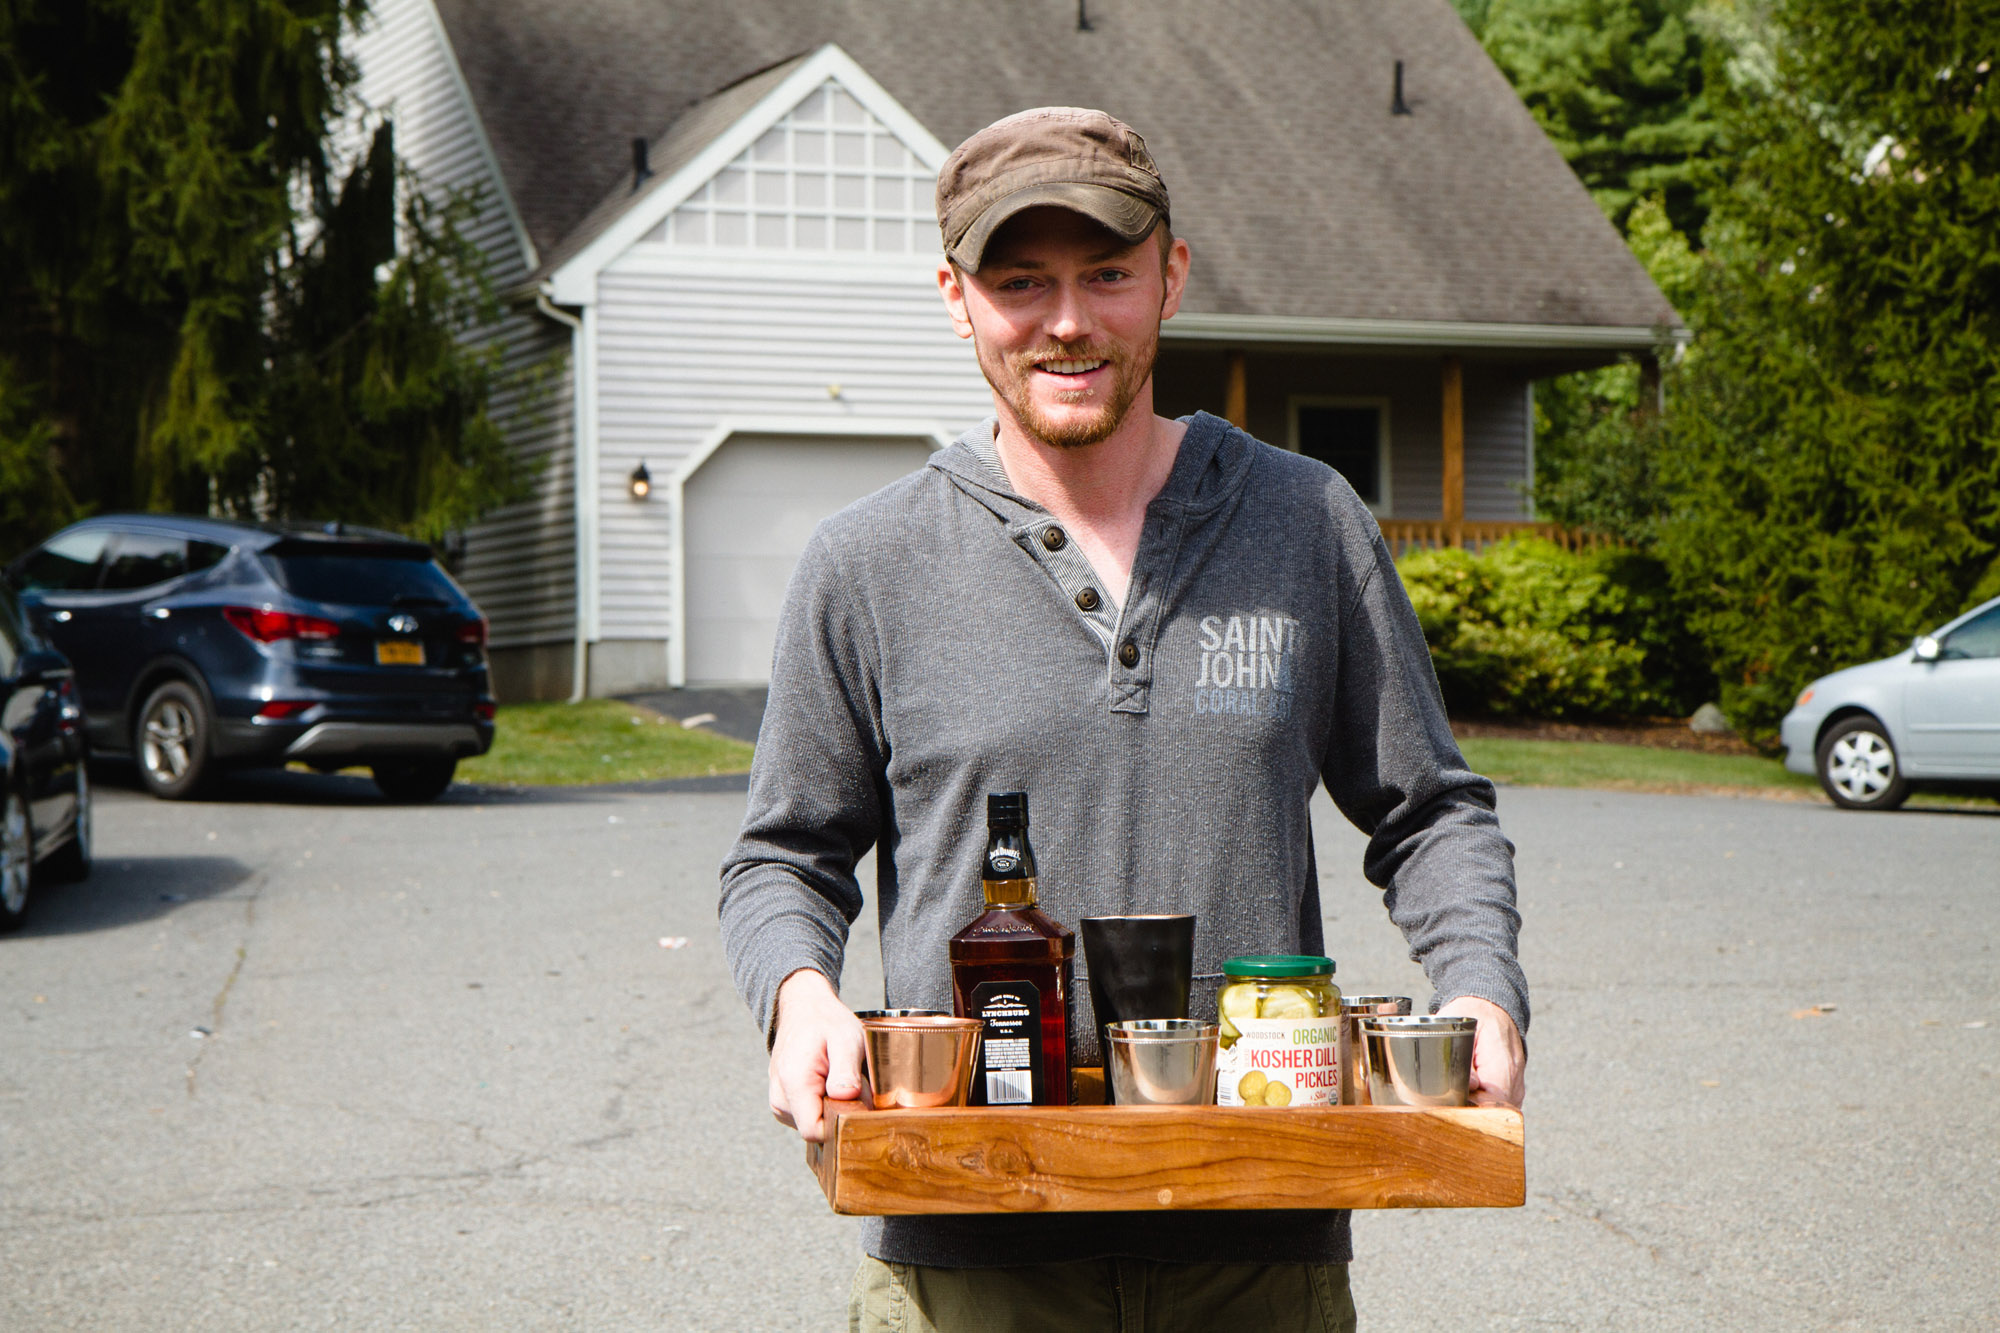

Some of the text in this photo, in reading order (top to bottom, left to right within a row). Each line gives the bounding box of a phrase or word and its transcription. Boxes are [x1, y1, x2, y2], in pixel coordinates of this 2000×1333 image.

[1199, 615, 1299, 653] SAINT
[1195, 652, 1283, 691] JOHN
[1195, 689, 1262, 715] CORAL
[982, 1009, 1030, 1018] LYNCHBURG
[1245, 1031, 1286, 1040] WOODSTOCK
[1292, 1025, 1337, 1045] ORGANIC
[1251, 1049, 1313, 1068] KOSHER
[1315, 1046, 1337, 1067] DILL
[1295, 1069, 1337, 1089] PICKLES
